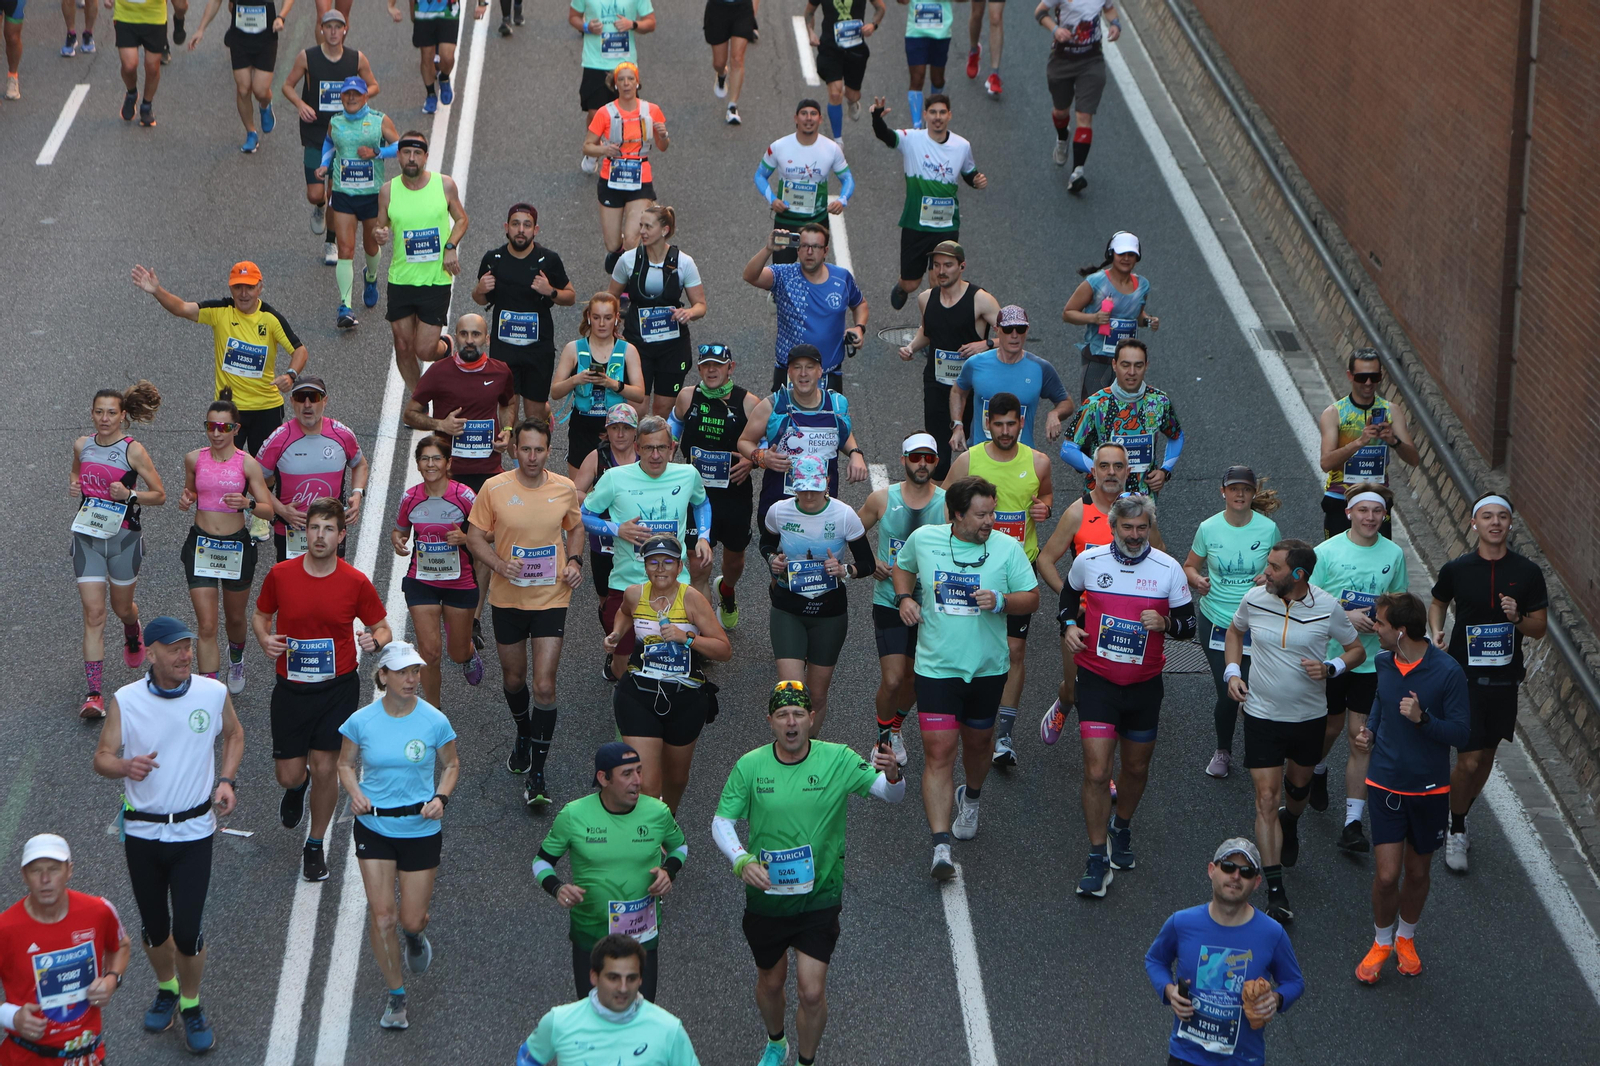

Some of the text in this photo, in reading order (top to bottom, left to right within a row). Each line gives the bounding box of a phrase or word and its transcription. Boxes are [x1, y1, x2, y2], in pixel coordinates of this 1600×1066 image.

[650, 326, 670, 334] DELPHINE
[241, 344, 263, 353] ZURICH
[237, 355, 254, 363] 12353
[701, 464, 717, 472] 12165
[96, 502, 121, 512] ZURICH
[92, 511, 108, 521] 10885
[999, 513, 1022, 521] ZURICH
[90, 520, 104, 529] SARA
[650, 522, 672, 530] ZURICH
[782, 526, 805, 534] SEVILLA
[213, 542, 238, 550] ZURICH
[527, 549, 551, 557] ZURICH
[527, 563, 541, 571] 7709
[523, 571, 543, 579] CARLOS
[949, 574, 975, 583] ZURICH
[801, 583, 827, 592] LAURENCE
[948, 589, 965, 597] 11404
[1116, 623, 1143, 632] ZURICH
[1112, 635, 1130, 645] 11511
[300, 642, 327, 650] ZURICH
[1107, 643, 1134, 653] @MSAN70
[300, 657, 319, 665] 12366
[776, 852, 805, 861] ZURICH
[56, 948, 88, 964] ZURICH
[1204, 1006, 1234, 1017] ZURICH
[1198, 1019, 1219, 1033] 12151
[1187, 1025, 1206, 1039] BRIAN
